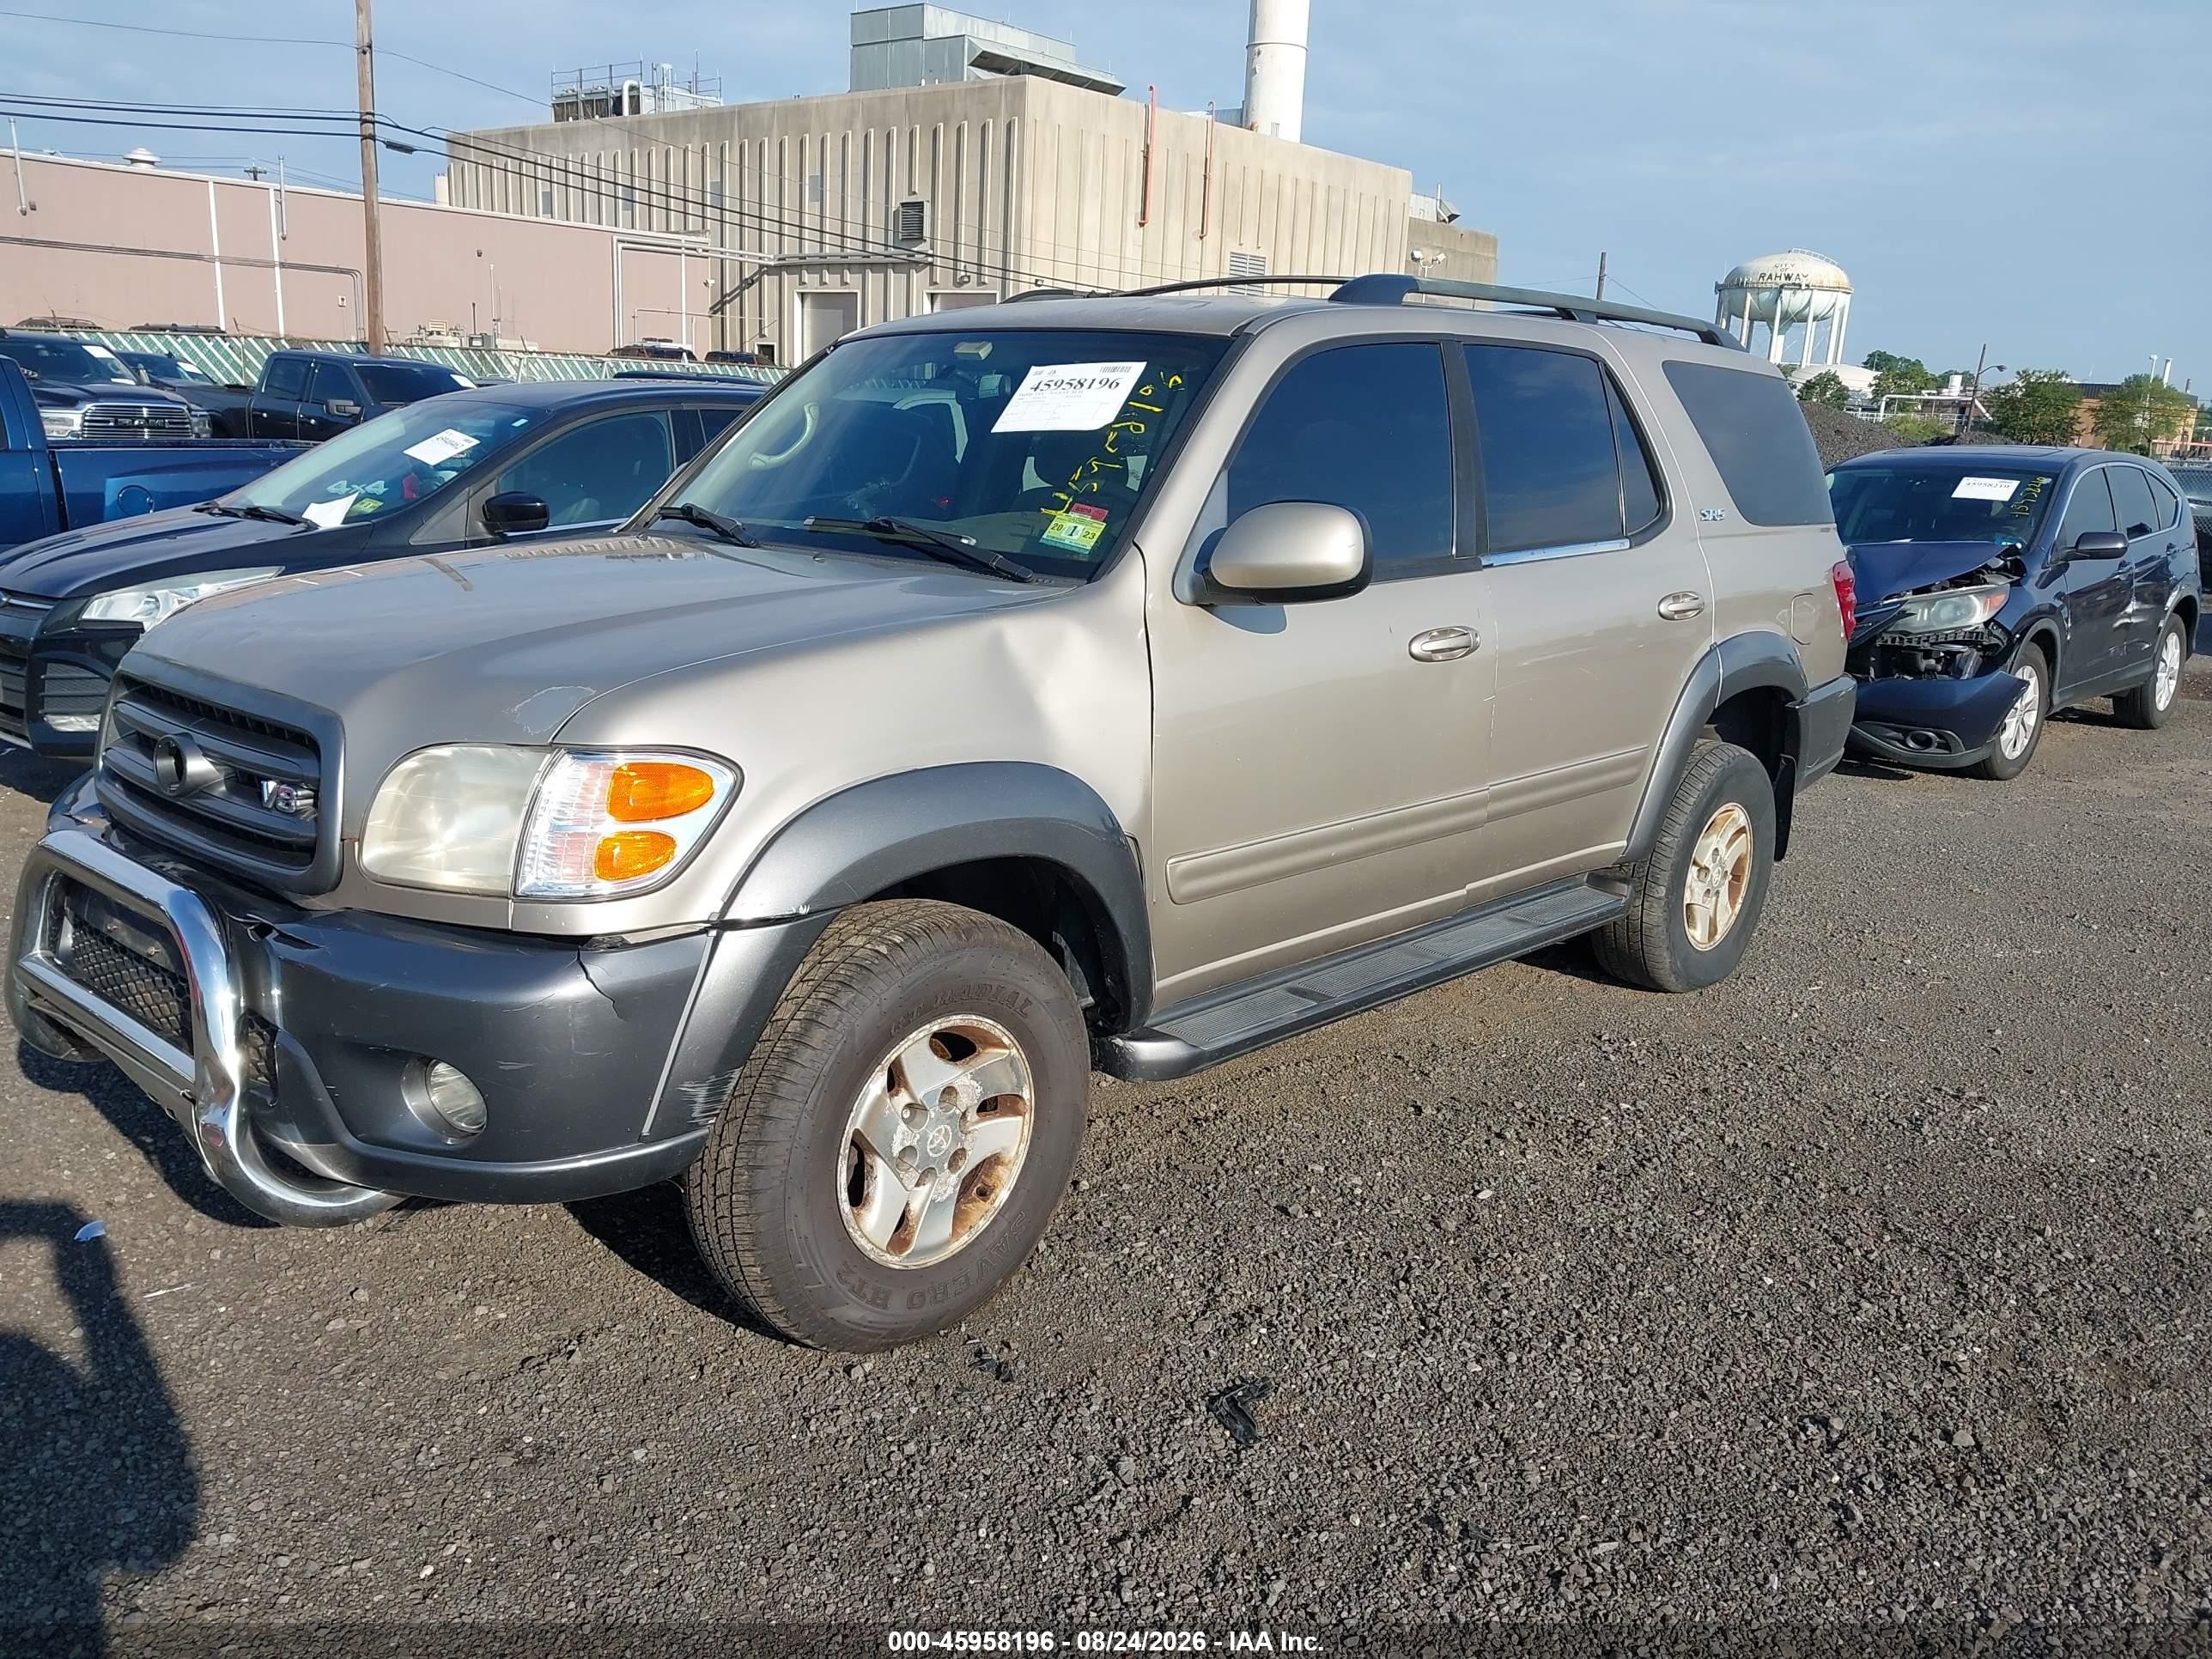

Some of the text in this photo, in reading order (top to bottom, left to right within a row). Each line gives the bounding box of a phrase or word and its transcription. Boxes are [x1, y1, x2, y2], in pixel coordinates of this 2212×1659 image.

[1758, 272, 1809, 283] RAHWAY
[1030, 376, 1123, 393] 45958196
[1050, 522, 1064, 532] 20
[1067, 526, 1078, 537] 1
[260, 780, 302, 814] V8
[906, 1210, 1028, 1311] SAVERO
